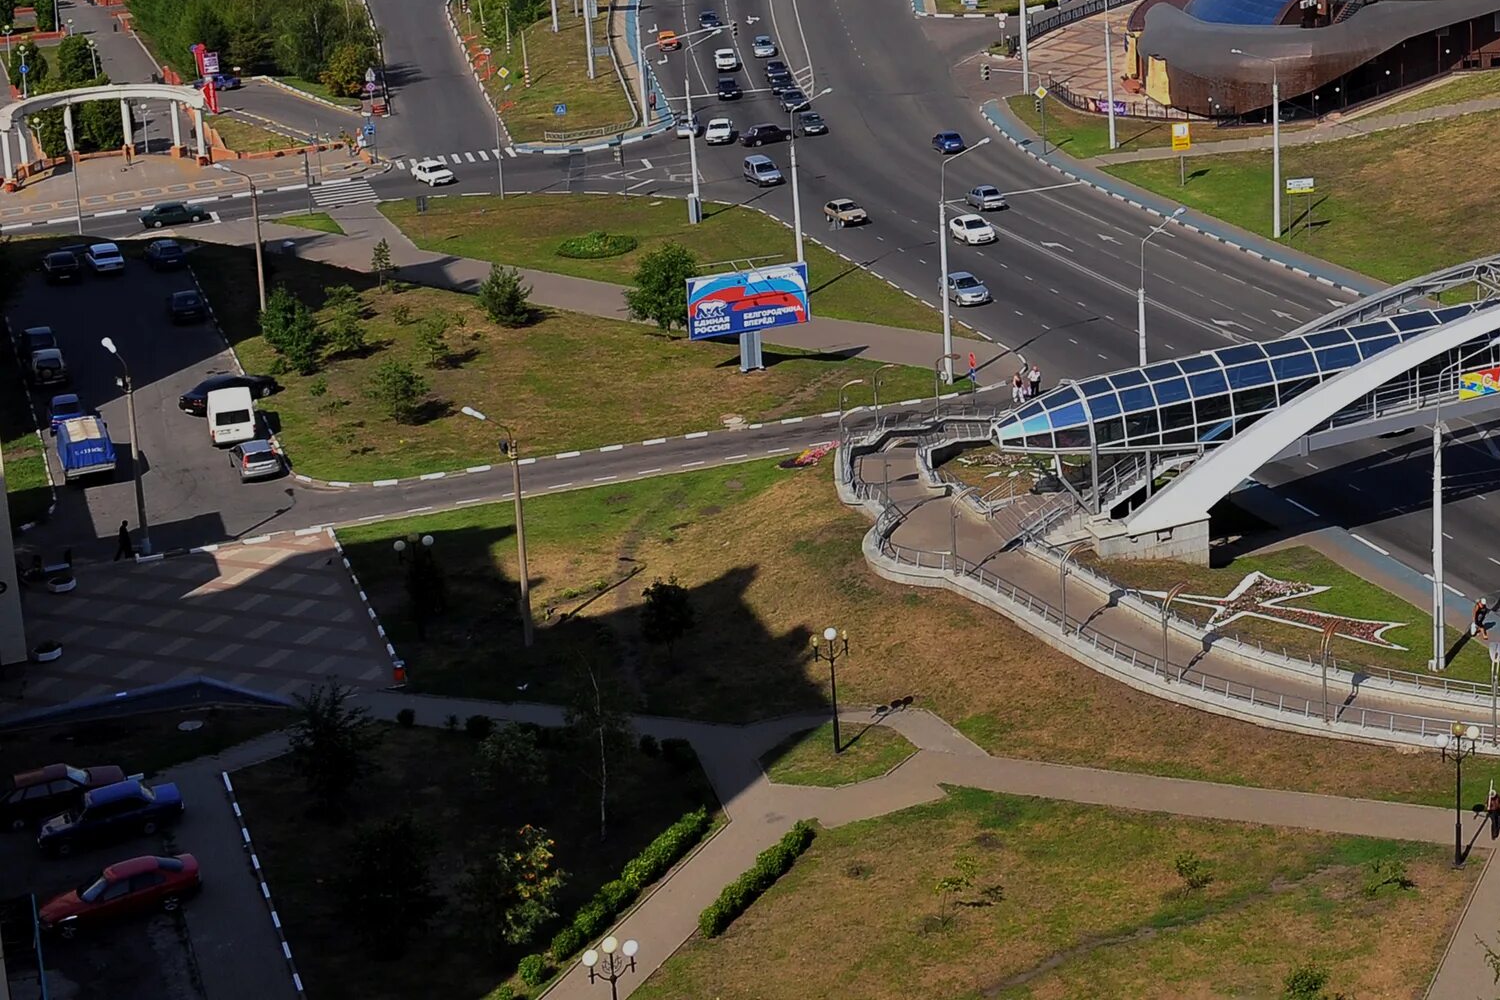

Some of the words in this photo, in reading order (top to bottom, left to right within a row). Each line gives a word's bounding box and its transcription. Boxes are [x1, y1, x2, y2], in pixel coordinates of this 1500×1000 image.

[694, 316, 731, 328] ЕДИНАЯ
[694, 323, 731, 335] РОССИЯ
[1481, 367, 1494, 387] С
